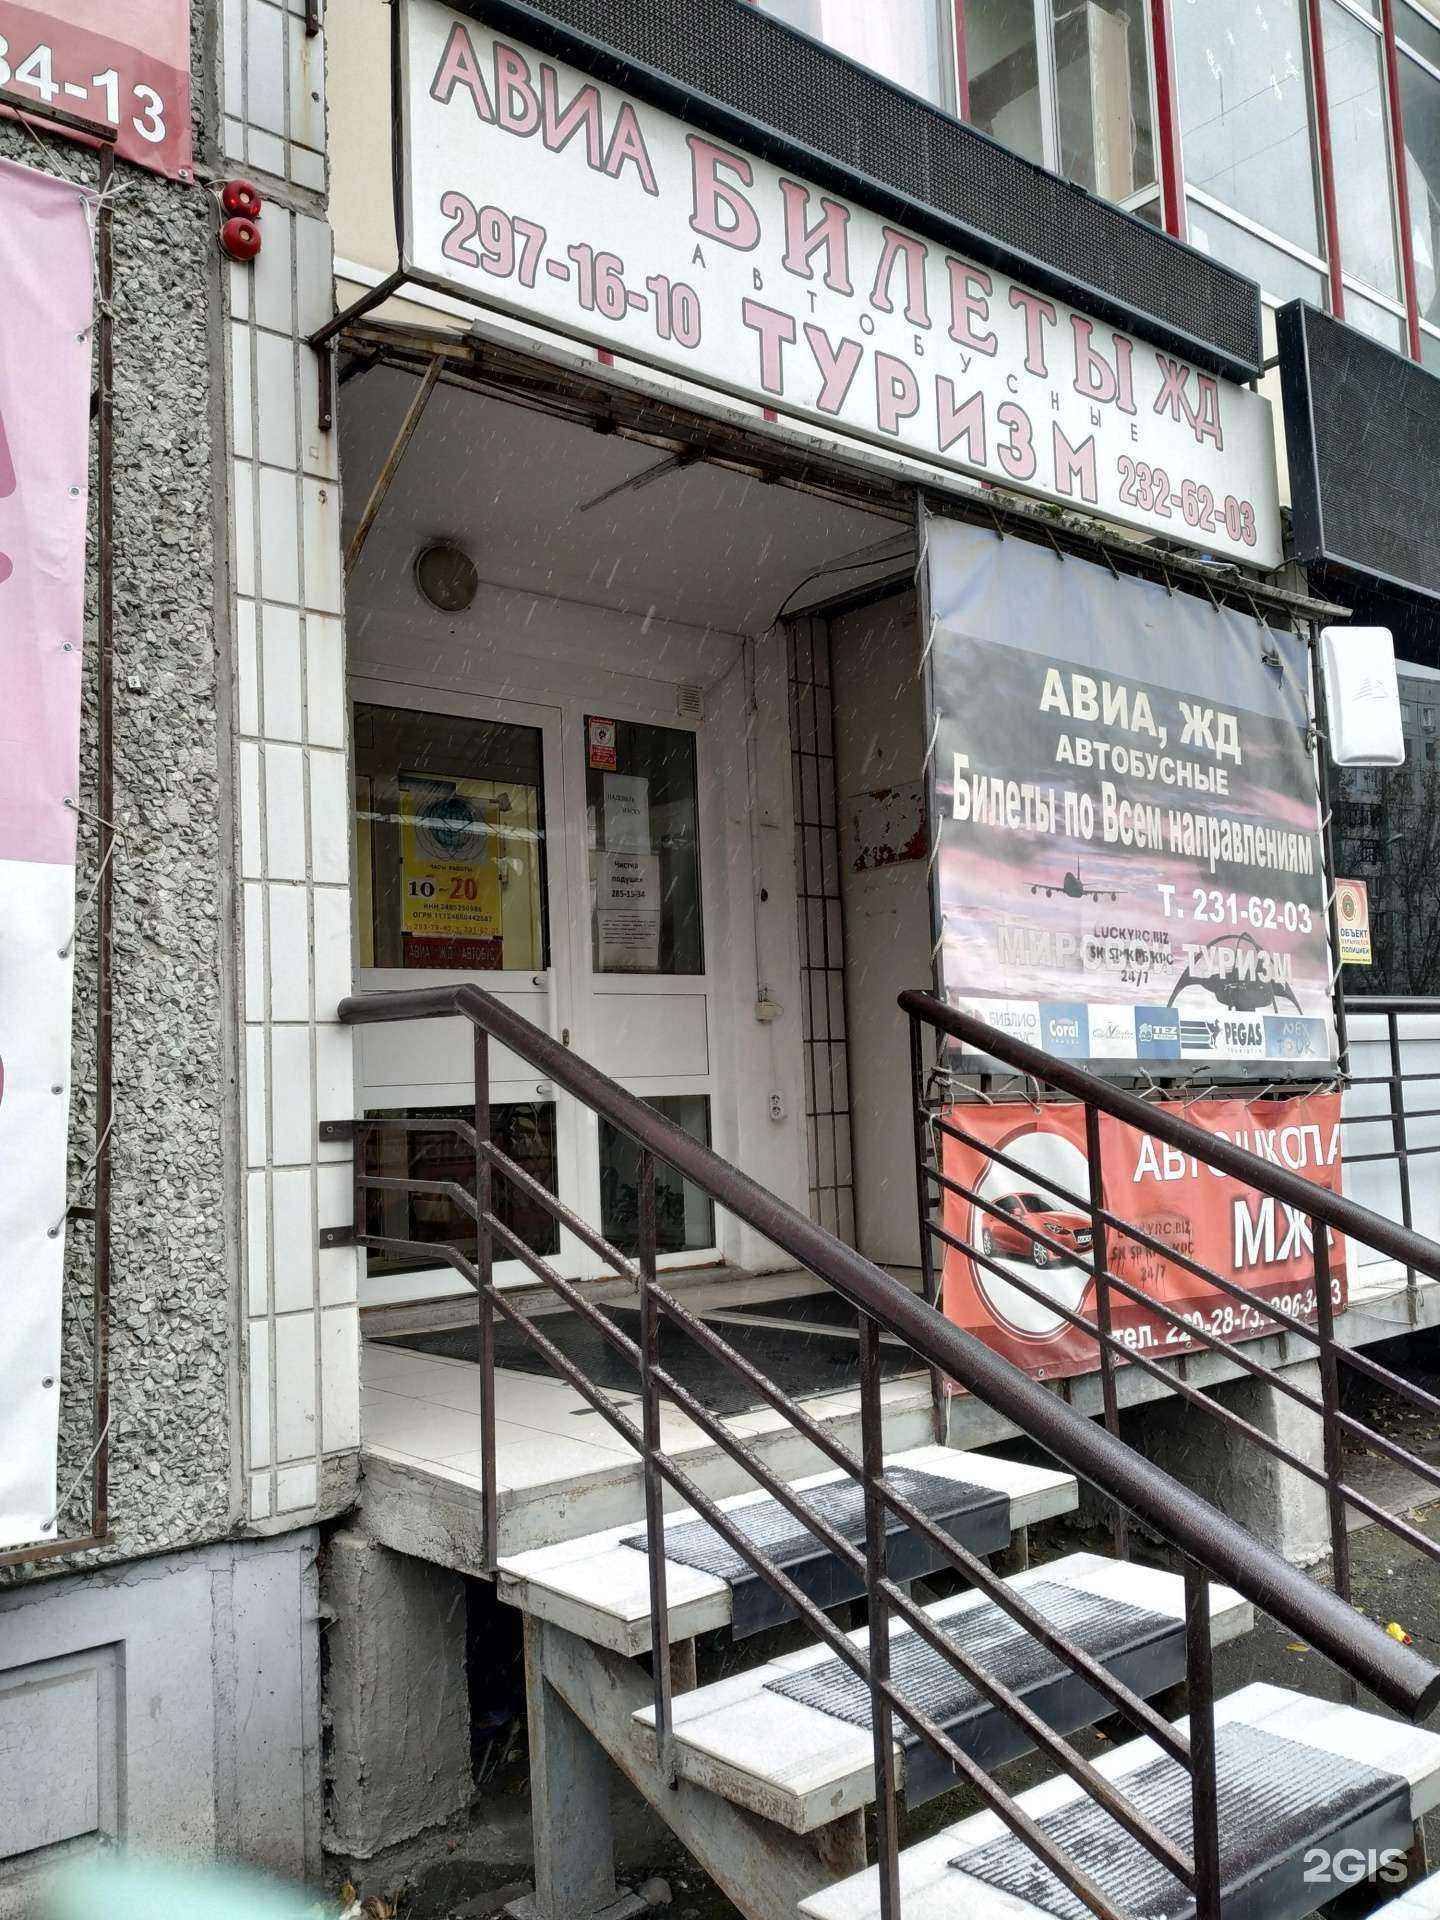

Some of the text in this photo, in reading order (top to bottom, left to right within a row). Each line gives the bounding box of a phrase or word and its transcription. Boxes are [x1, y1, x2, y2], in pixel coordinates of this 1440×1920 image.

[429, 21, 1224, 452] АВИА БИЛЕТЫ ЖД
[440, 190, 701, 349] 297-16-10
[742, 297, 1098, 504] ТУРИЗМ
[1116, 454, 1258, 547] 232-62-03
[1039, 667, 1242, 765] АВИА, ЖД
[1055, 735, 1230, 796] АВТОБУСНЫЕ
[953, 752, 1314, 876] Билеты по Всем направлениям
[1193, 888, 1313, 935] 231-62-03
[1340, 928, 1368, 938] ОБЪЕКТ
[1120, 969, 1150, 987] 24/7
[1182, 942, 1293, 985] ТУРИЗМ
[1050, 1019, 1079, 1038] Coral
[1224, 1022, 1263, 1047] PEGAS
[1234, 1197, 1334, 1268] МЖ
